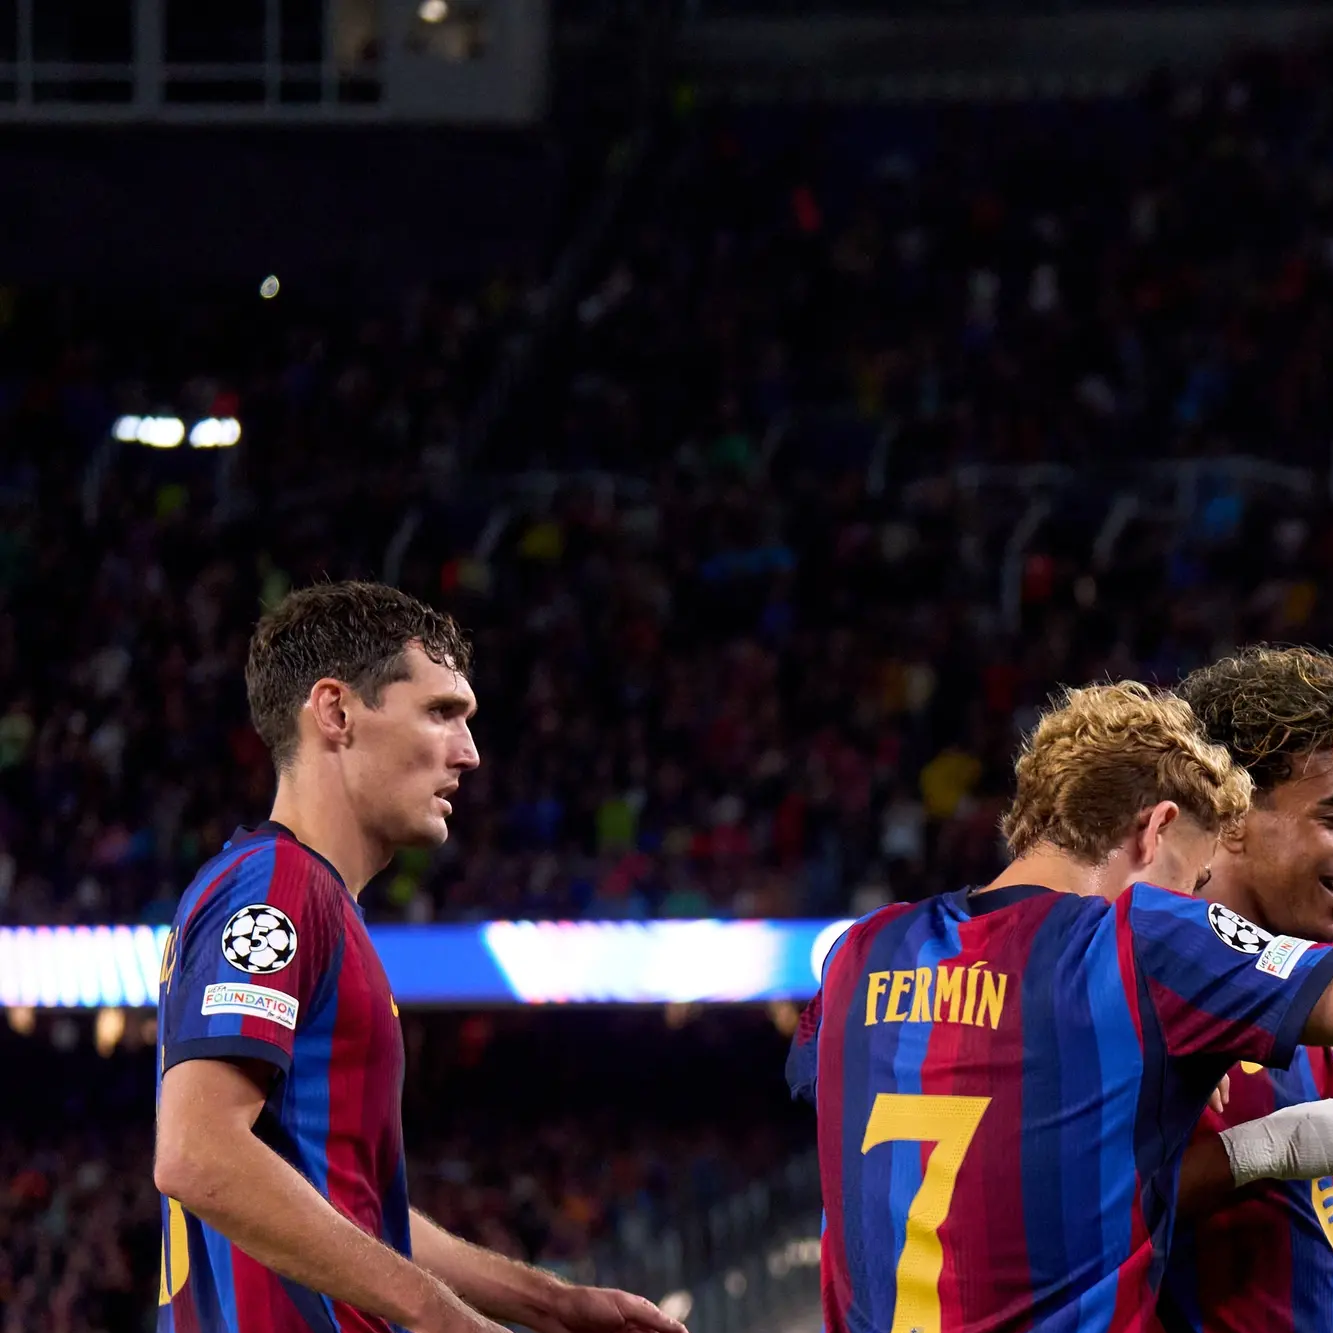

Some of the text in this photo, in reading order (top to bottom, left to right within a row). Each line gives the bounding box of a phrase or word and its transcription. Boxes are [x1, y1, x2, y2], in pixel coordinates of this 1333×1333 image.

[249, 926, 269, 952] 5
[207, 985, 227, 994] UEFA
[864, 961, 1008, 1030] FERMÍN
[205, 992, 295, 1019] FOUNDATION
